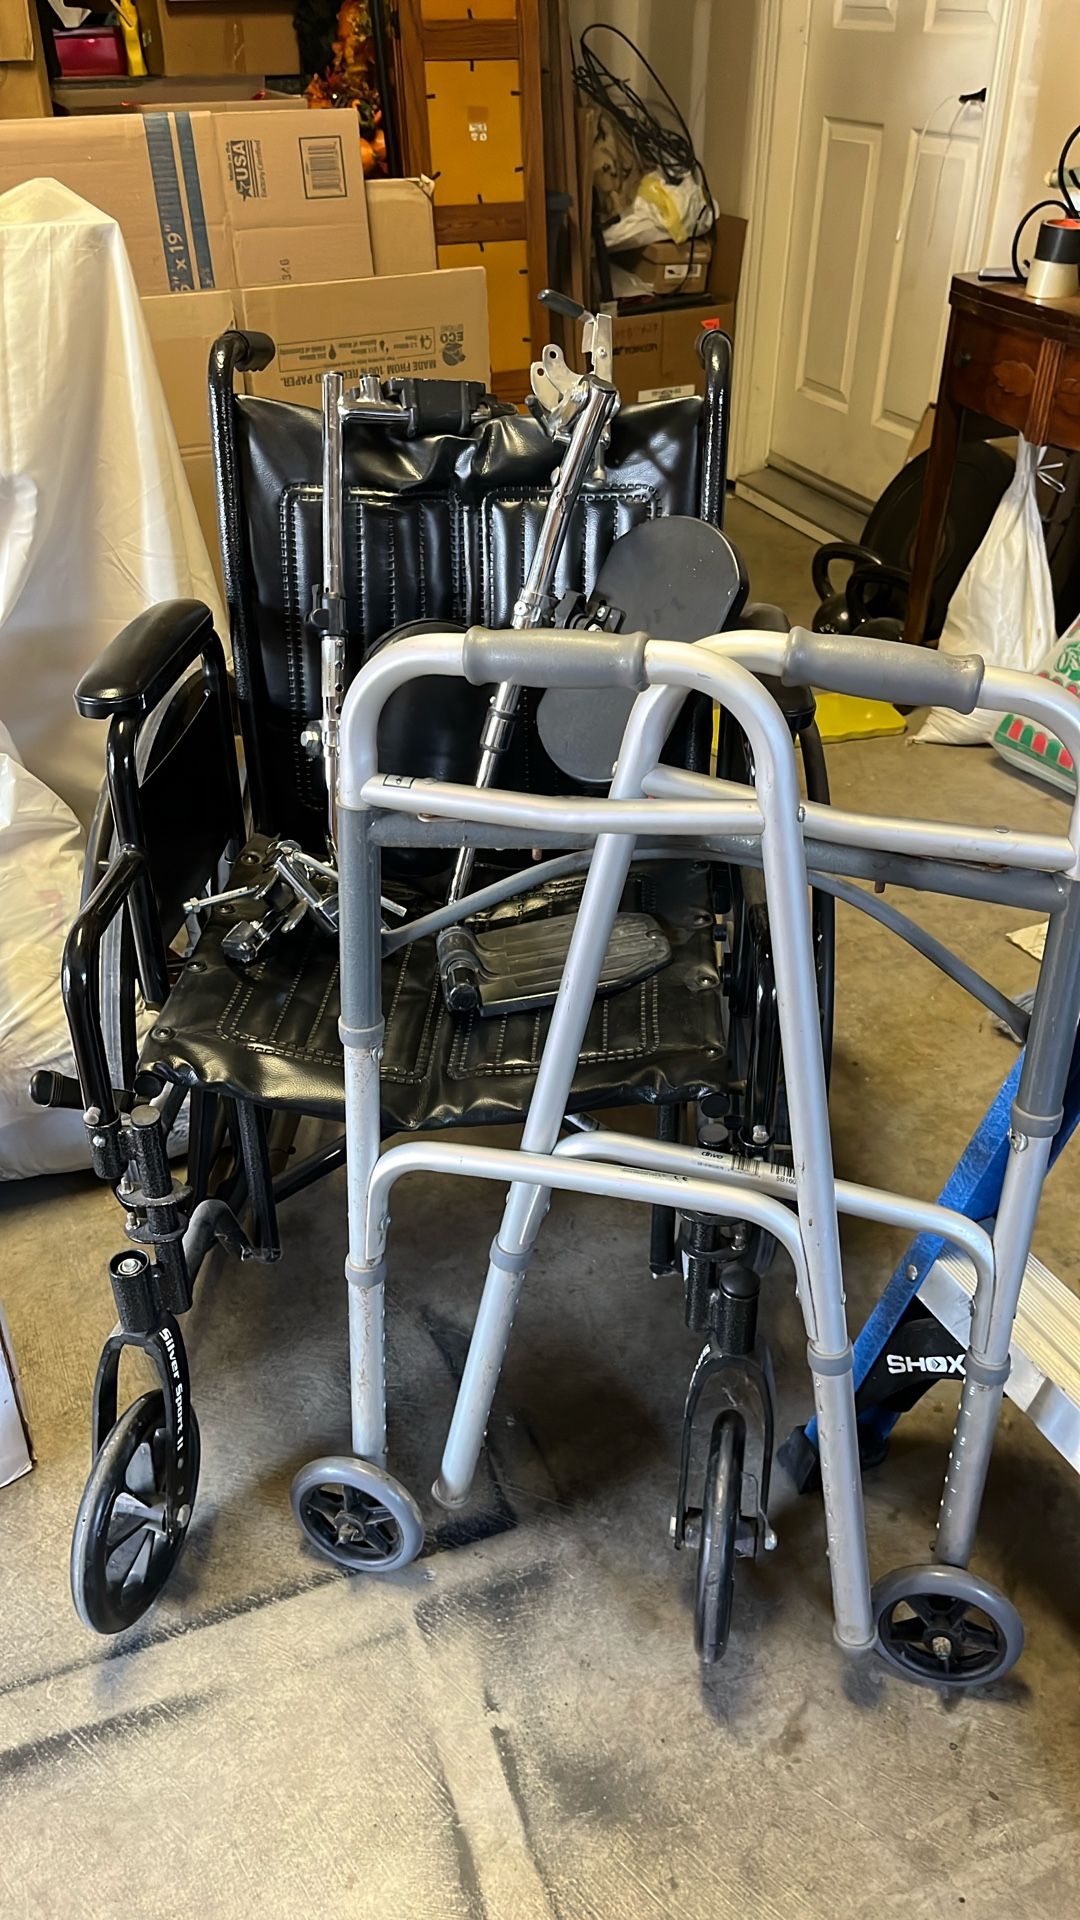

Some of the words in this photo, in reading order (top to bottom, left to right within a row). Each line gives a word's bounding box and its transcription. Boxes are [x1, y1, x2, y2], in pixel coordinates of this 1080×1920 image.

[233, 142, 248, 180] USA
[165, 224, 184, 253] 19"
[440, 331, 464, 342] ECO
[386, 363, 411, 375] FROM
[413, 359, 437, 371] MADE
[280, 375, 313, 387] PAPER.
[886, 1354, 967, 1375] SHOX
[159, 1328, 180, 1378] Silver
[175, 1383, 183, 1434] Sport
